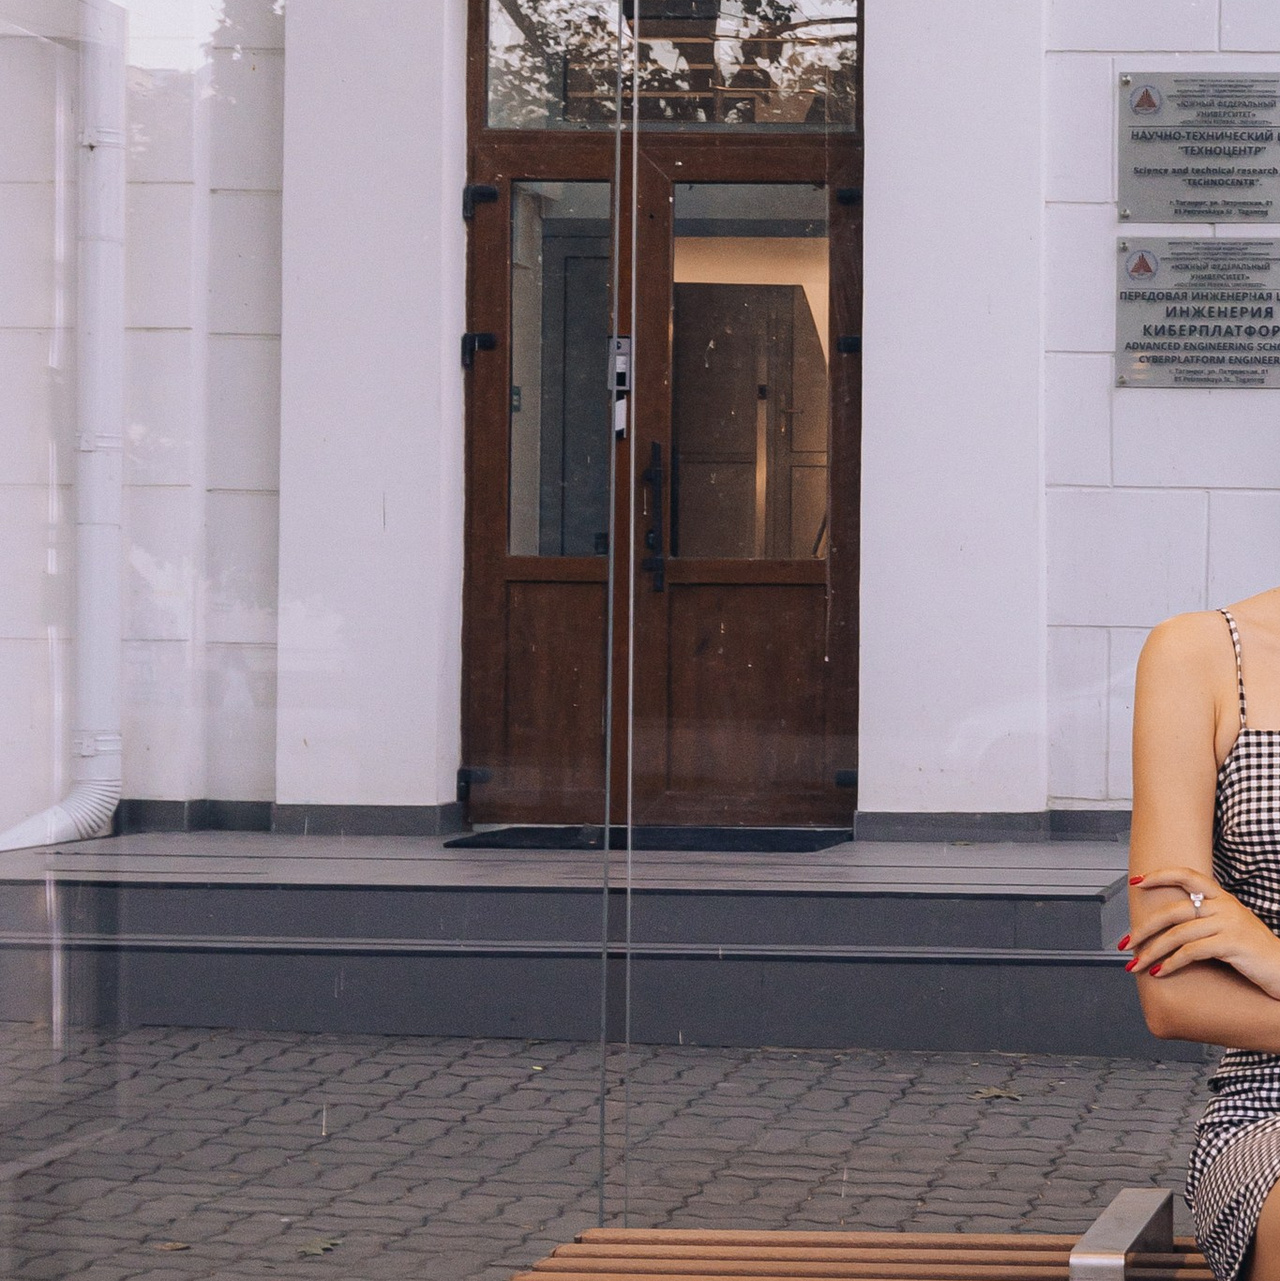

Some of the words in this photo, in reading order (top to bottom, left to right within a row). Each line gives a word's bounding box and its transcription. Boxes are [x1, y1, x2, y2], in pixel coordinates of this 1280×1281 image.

[1131, 129, 1273, 142] НАУЧНО-ТЕХНИЧЕСКИЙ
[1133, 166, 1169, 175] Science
[1171, 166, 1189, 175] and
[1192, 166, 1235, 175] technical
[1238, 166, 1278, 175] research
[1119, 291, 1188, 302] ПЕРЕДОВАЯ
[1192, 291, 1273, 302] ИНЖЕНЕРНАЯ
[1165, 306, 1274, 319] ИНЖЕНЕРИЯ
[1125, 341, 1181, 351] ADVANCED
[1183, 341, 1254, 351] ENGINEERING
[1139, 355, 1226, 365] CYBERPLATFORM
